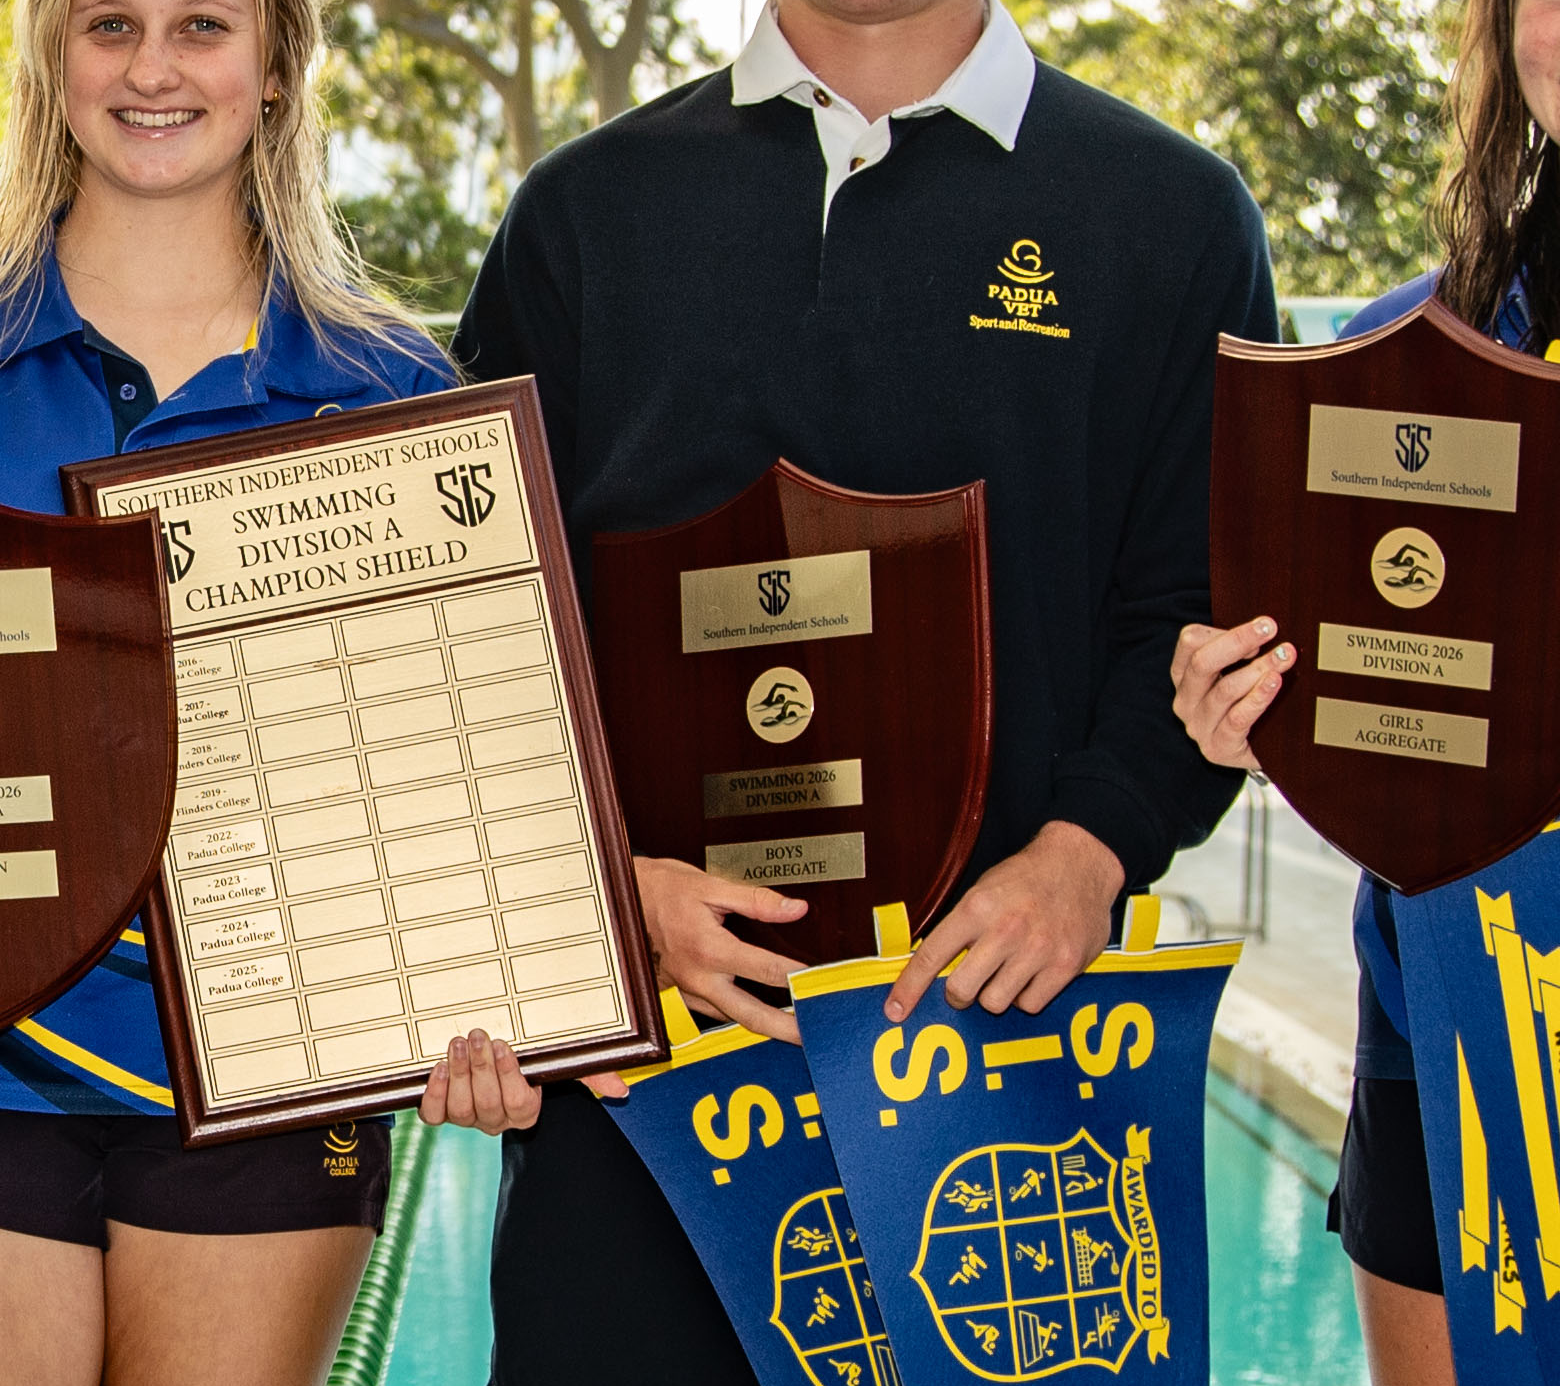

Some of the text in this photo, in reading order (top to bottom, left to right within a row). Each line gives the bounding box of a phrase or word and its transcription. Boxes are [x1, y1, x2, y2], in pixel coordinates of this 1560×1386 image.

[988, 284, 1060, 306] PADUA
[1003, 301, 1043, 318] VET
[969, 315, 1070, 339] Sport and Recreation
[117, 428, 499, 516] SOUTHERN INDEPENDENT SCHOOLS
[1331, 470, 1492, 499] Southern Independent Schools
[232, 482, 396, 534] SWIMMING
[237, 517, 403, 569] DIVISION A
[185, 539, 467, 612] CHAMPION SHIELD
[703, 613, 849, 641] Southern Independent Schools
[1346, 633, 1464, 661] SWIMMING 2026
[186, 665, 222, 677] College
[1362, 654, 1445, 678] DIVISION A
[1379, 713, 1424, 732] GIRLS
[191, 744, 212, 755] 2018
[1355, 729, 1446, 754] AGGREGATE
[729, 769, 836, 792] SWIMMING 2026
[201, 788, 221, 799] 2019
[745, 790, 821, 810] DIVISION A
[176, 797, 251, 817] Flinders College
[206, 831, 232, 843] 2022
[187, 840, 256, 861] Padua College
[765, 845, 803, 861] BOYS
[743, 860, 827, 881] AGGREGATE
[213, 875, 241, 888] 2023
[192, 885, 267, 906] Padua College
[221, 920, 249, 933] 2024
[200, 929, 276, 951] Padua College
[230, 964, 258, 978] 2025
[208, 974, 284, 996] Padua College
[323, 1156, 360, 1168] PADUA
[1125, 1166, 1158, 1321] AWARDED TO
